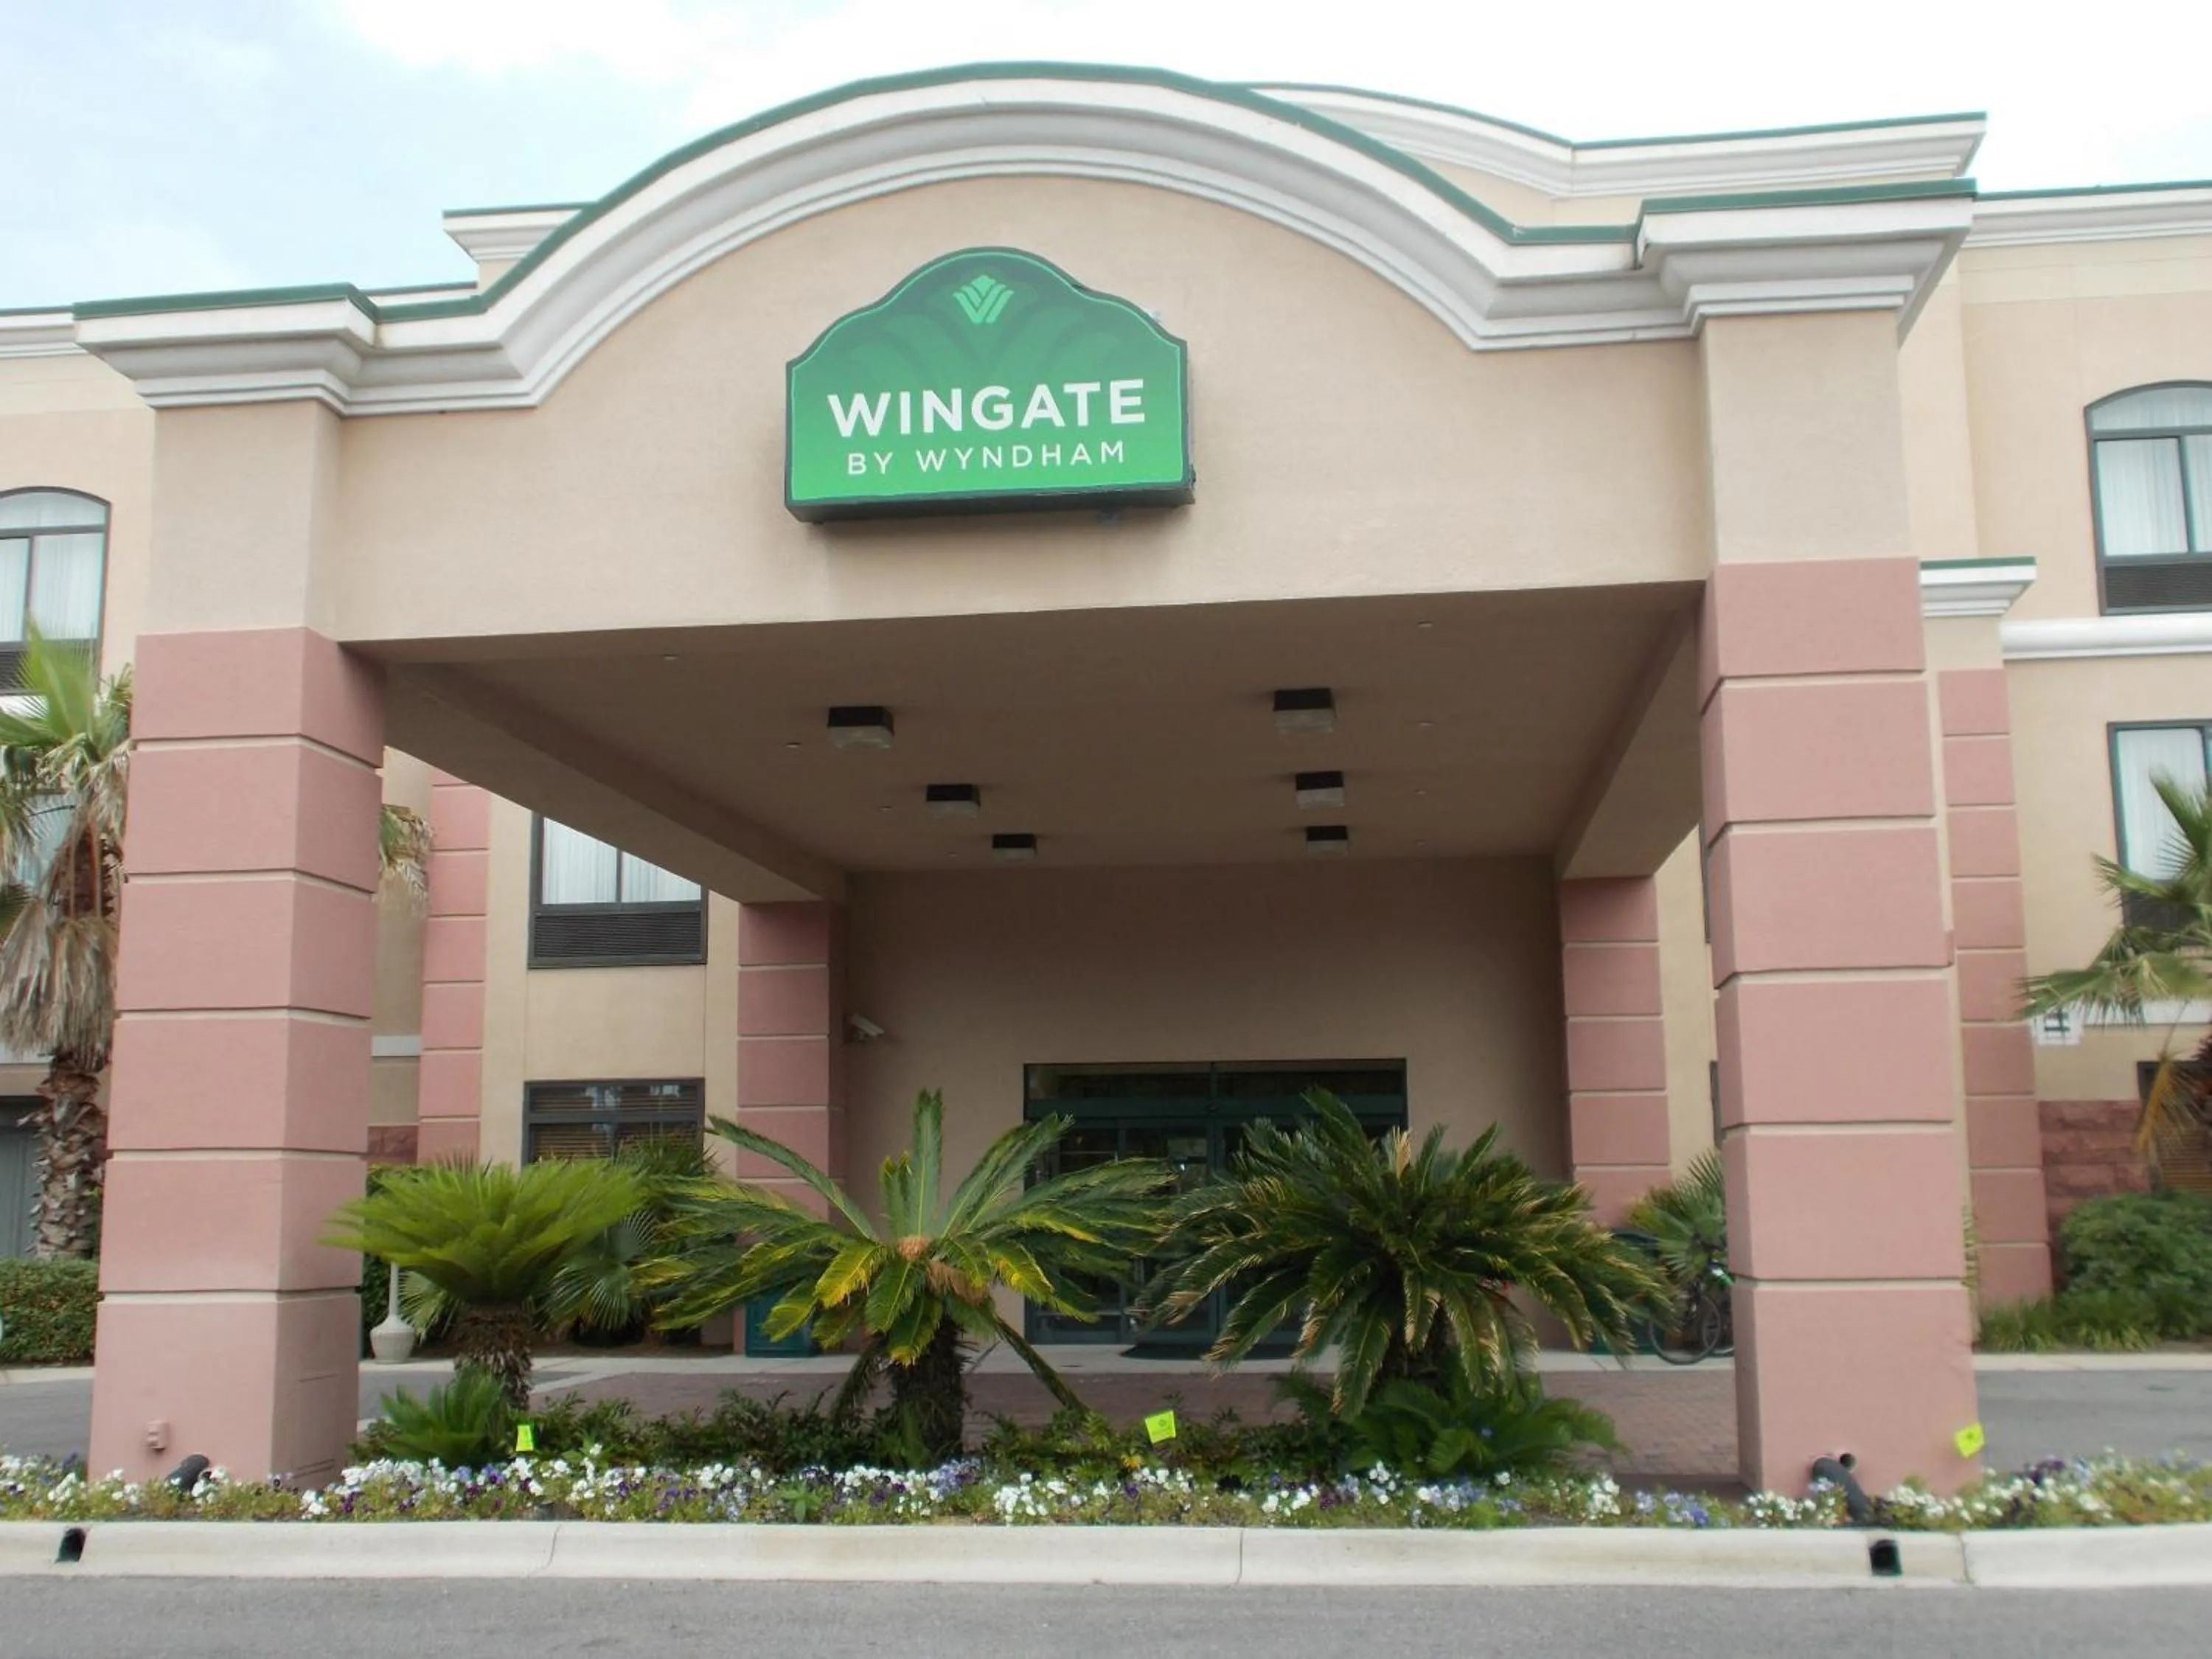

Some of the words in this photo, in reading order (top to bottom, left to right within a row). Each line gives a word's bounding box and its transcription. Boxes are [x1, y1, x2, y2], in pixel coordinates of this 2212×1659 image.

[827, 378, 1145, 437] WINGATE
[847, 452, 894, 476] BY
[916, 440, 1124, 473] WYNDHAM
